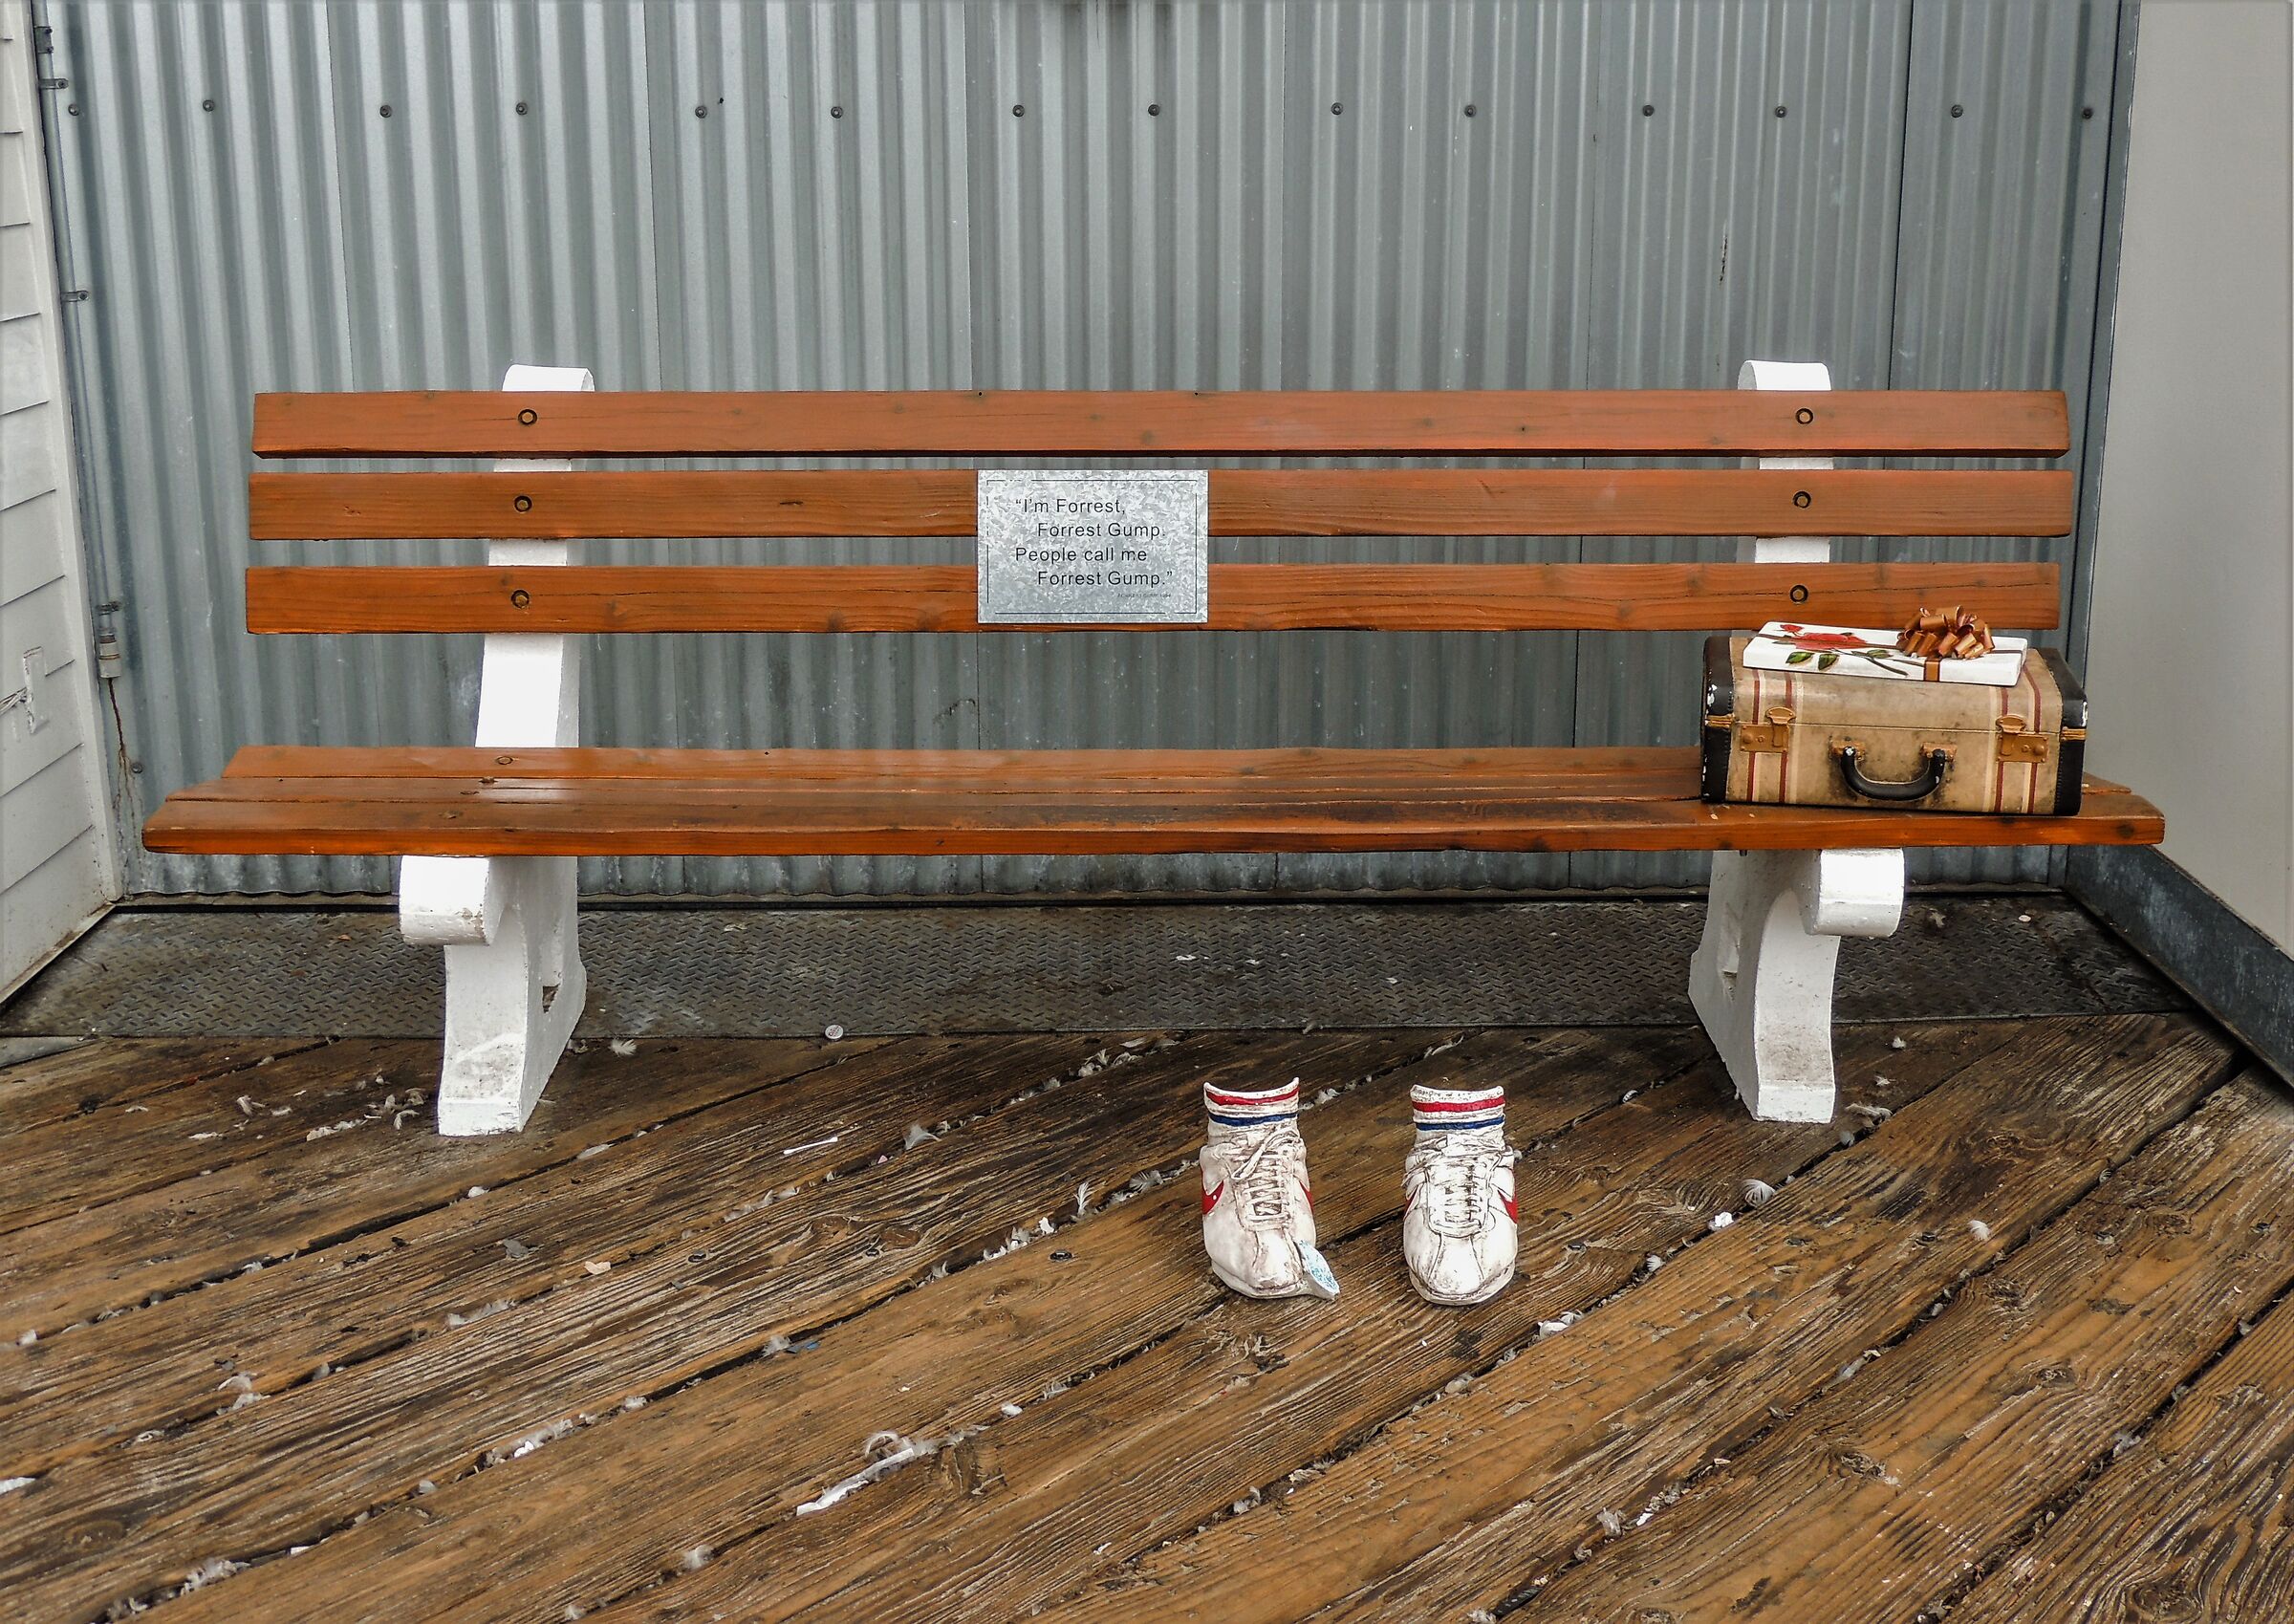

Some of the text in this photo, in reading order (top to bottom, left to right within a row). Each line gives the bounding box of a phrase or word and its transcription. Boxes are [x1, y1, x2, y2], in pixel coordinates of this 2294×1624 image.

[1056, 499, 1125, 516] Forrest,
[1038, 523, 1165, 541] Forrest Gump.
[1015, 546, 1148, 565] People call me
[1038, 571, 1102, 586] Forrest
